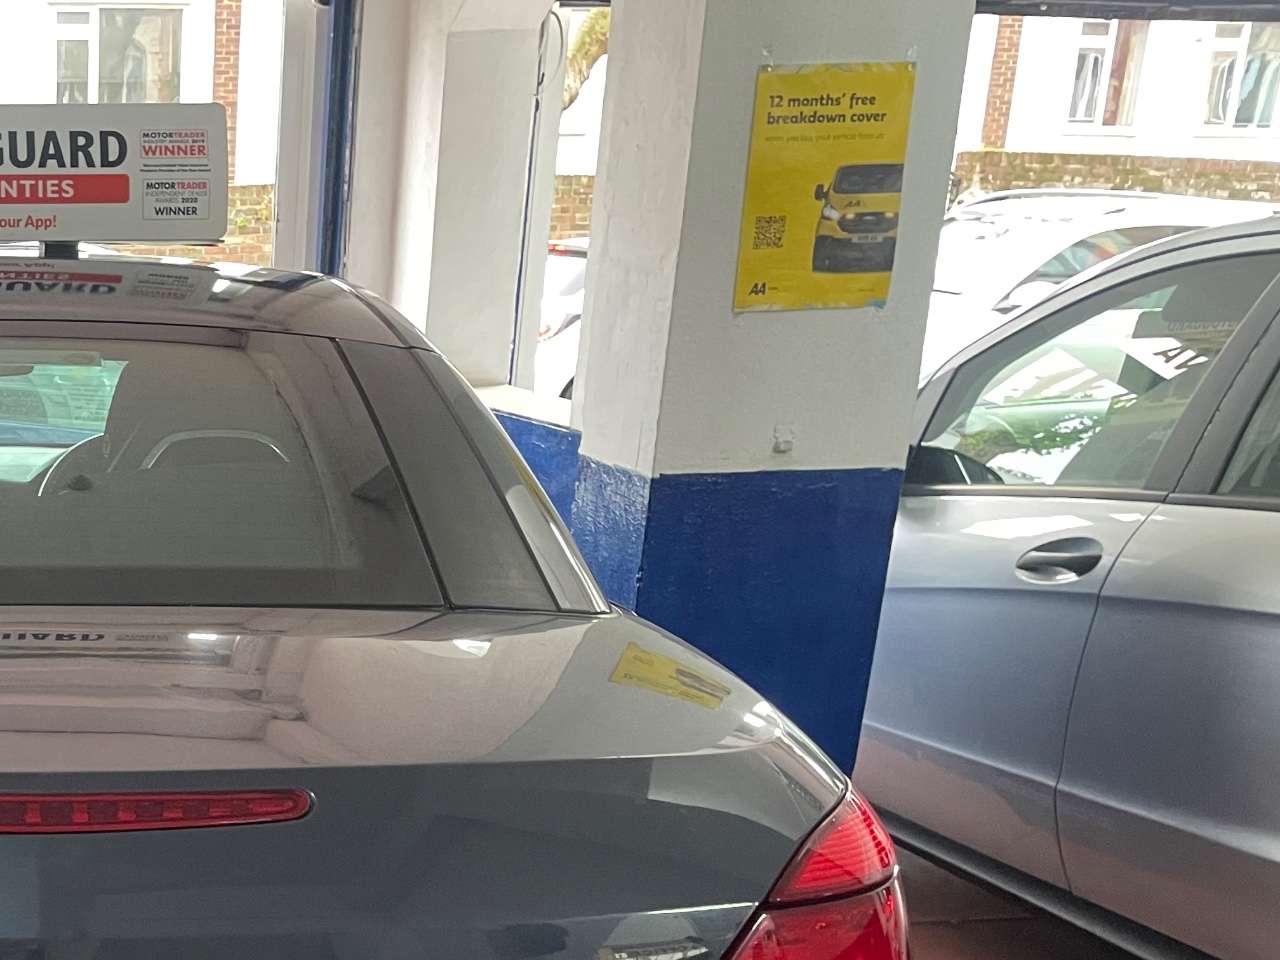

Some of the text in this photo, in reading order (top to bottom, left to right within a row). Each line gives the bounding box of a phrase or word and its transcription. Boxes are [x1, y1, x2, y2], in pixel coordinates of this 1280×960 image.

[769, 95, 784, 108] 12
[849, 92, 876, 109] free
[767, 110, 887, 125] breakdown cover
[142, 145, 207, 157] WINNER
[154, 207, 198, 216] WINNER
[0, 218, 23, 228] our
[24, 215, 57, 232] App!
[748, 282, 766, 296] AA
